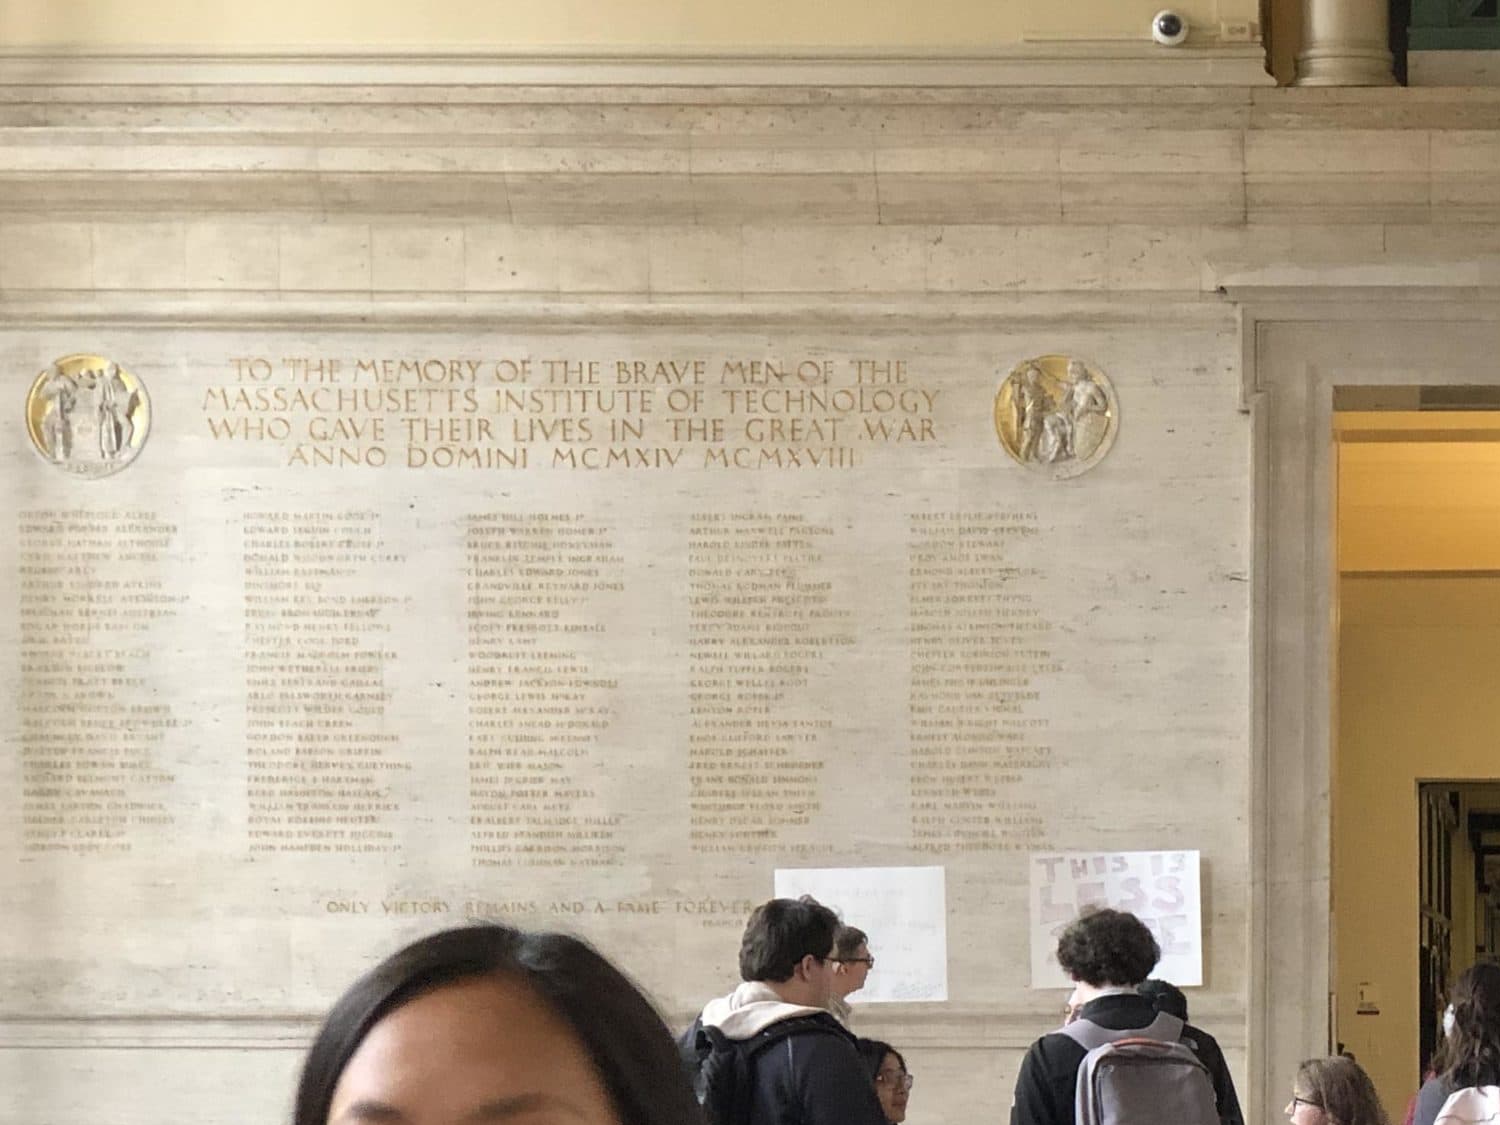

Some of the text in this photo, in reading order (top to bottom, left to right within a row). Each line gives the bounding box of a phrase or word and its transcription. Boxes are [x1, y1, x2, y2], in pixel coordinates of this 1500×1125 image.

[232, 359, 908, 385] TO THE MEMORY OF THE BRAVE MEN OF THE
[202, 389, 940, 414] MASSACHUSETTS INSTITUTE OF TECHNOLOGY
[207, 418, 938, 443] WHO GAVE THEIR LIVES IN THE GREAT WAR
[287, 447, 387, 470] ANNO
[406, 447, 529, 470] DOMINI
[704, 447, 856, 470] MCMXVIII
[1036, 855, 1129, 883] THIS
[326, 901, 368, 914] ONLY
[382, 901, 451, 914] VICTORY
[465, 901, 536, 914] REMAINS
[550, 901, 585, 914] AND
